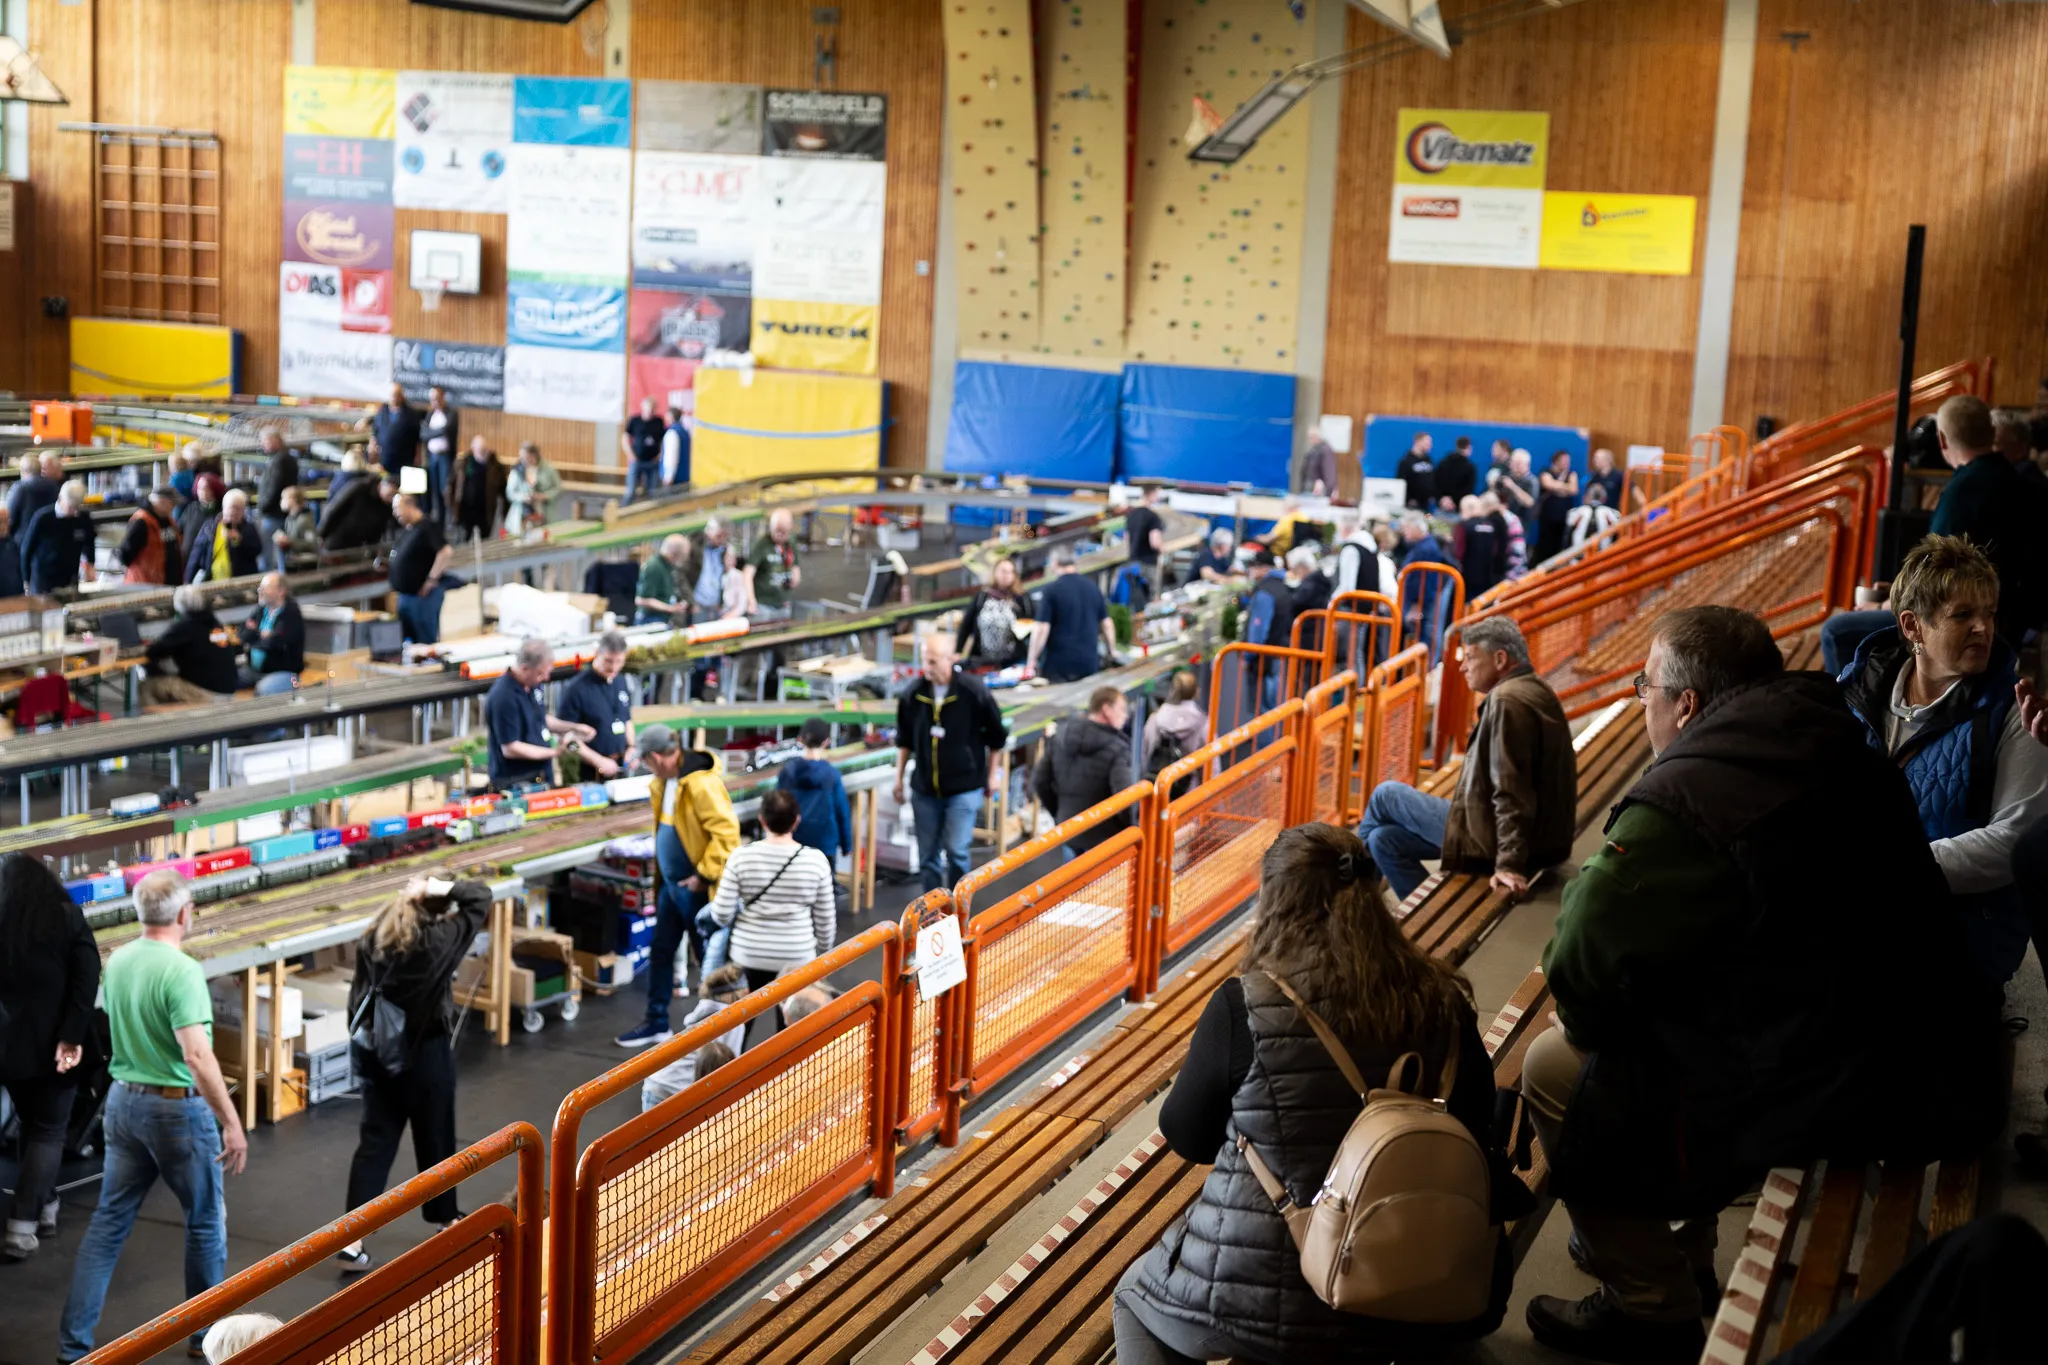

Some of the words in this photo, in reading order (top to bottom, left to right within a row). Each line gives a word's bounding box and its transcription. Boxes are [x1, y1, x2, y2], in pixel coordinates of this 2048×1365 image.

[1420, 134, 1535, 165] Vitamalz
[759, 320, 870, 340] TURCK
[435, 349, 504, 375] DIGITAL
